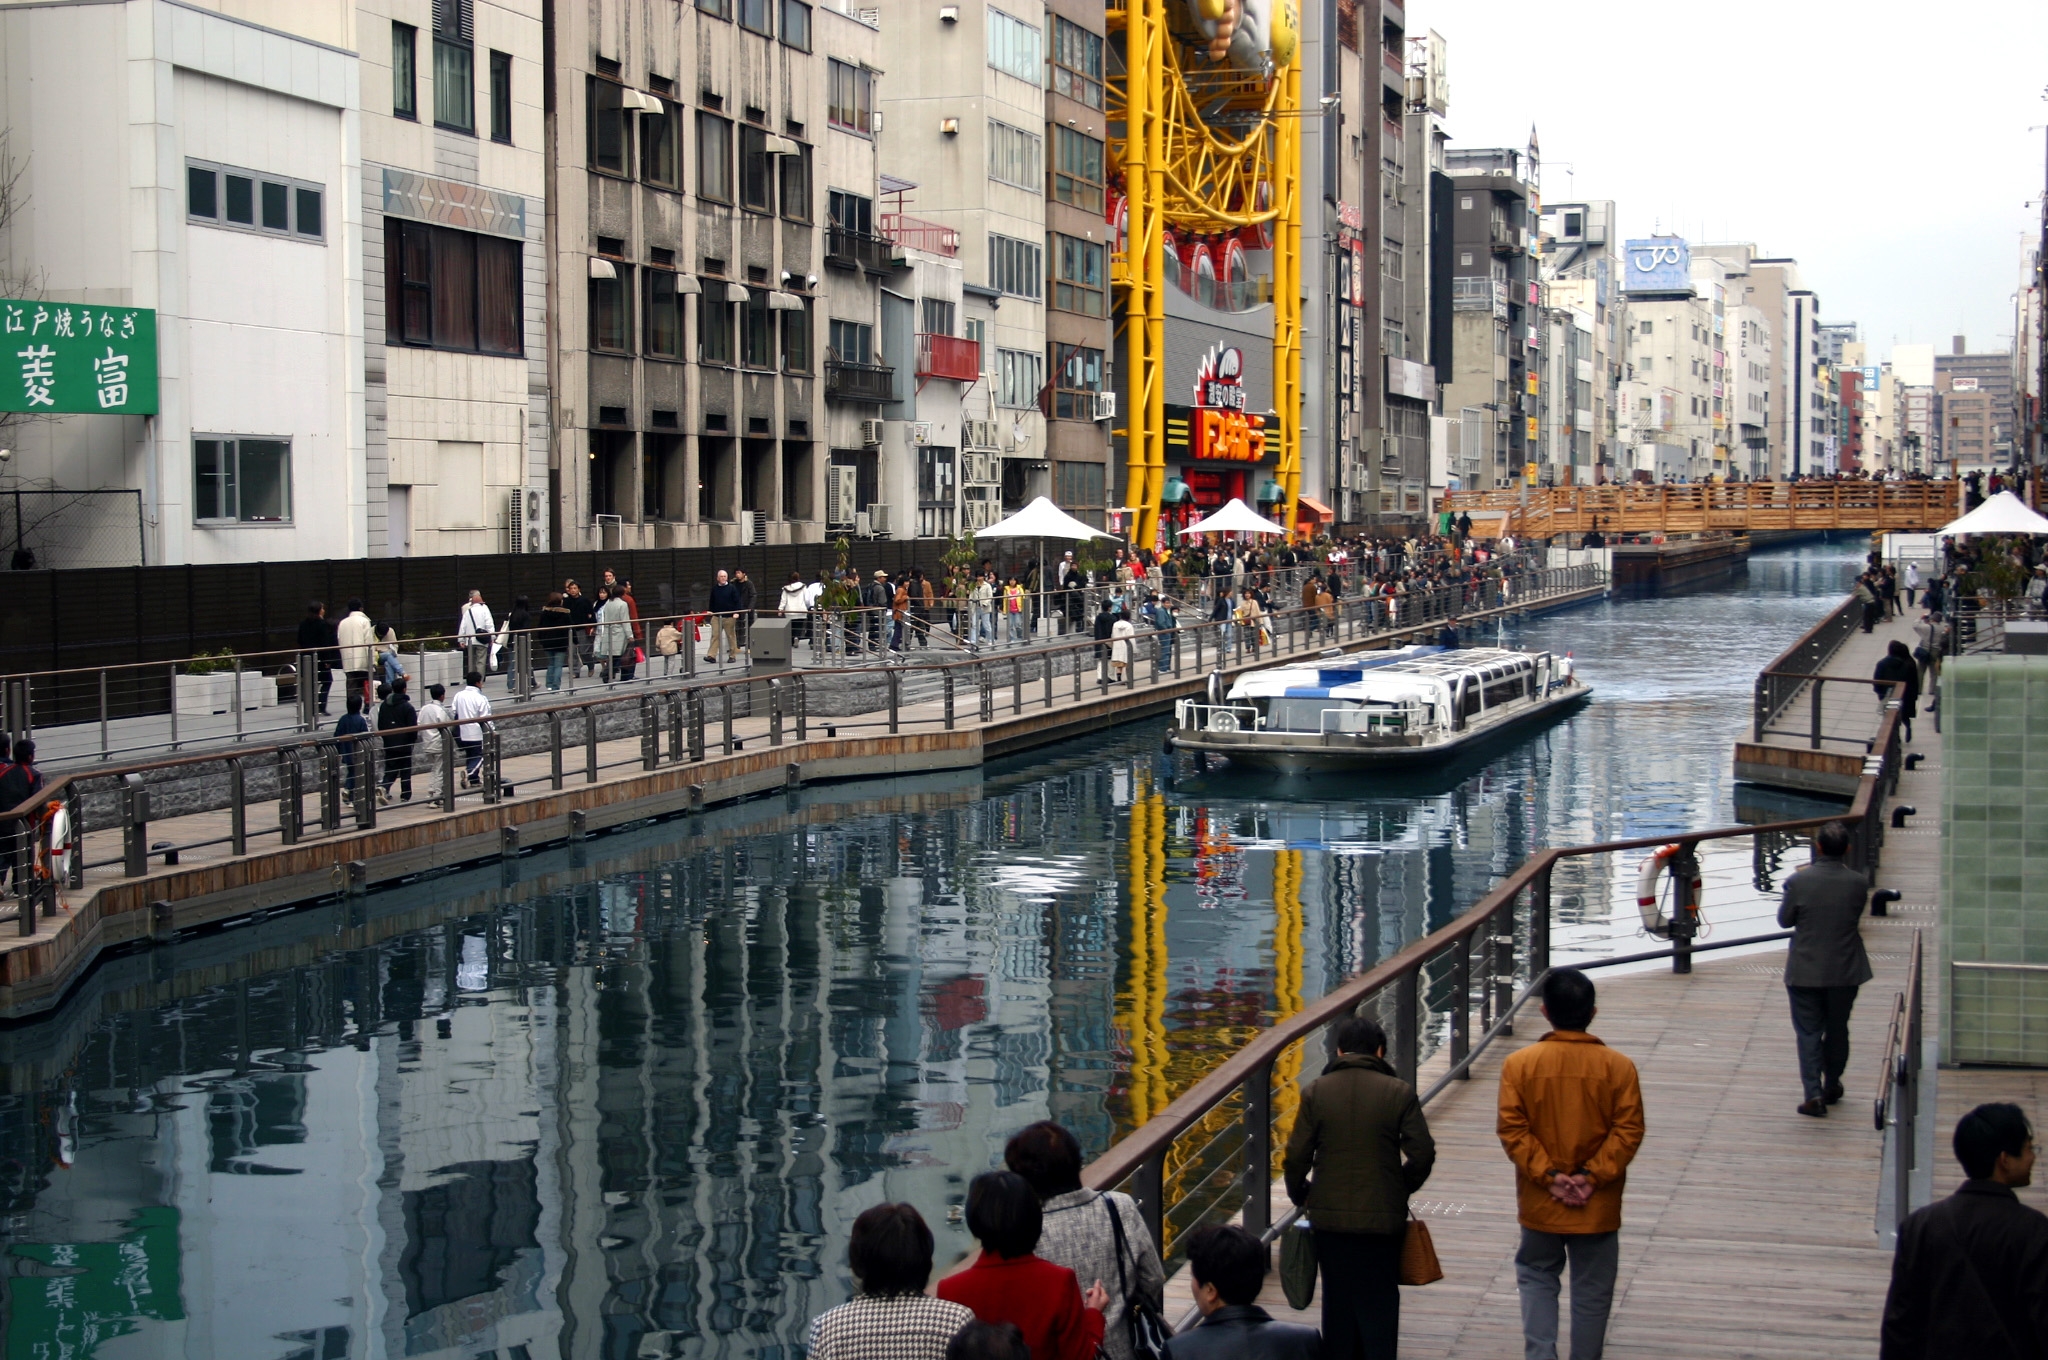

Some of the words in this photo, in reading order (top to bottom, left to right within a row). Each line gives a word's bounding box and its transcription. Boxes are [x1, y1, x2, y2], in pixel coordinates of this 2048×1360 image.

[6, 304, 138, 339] 江戸焼うなぎ
[17, 344, 129, 408] 菱富
